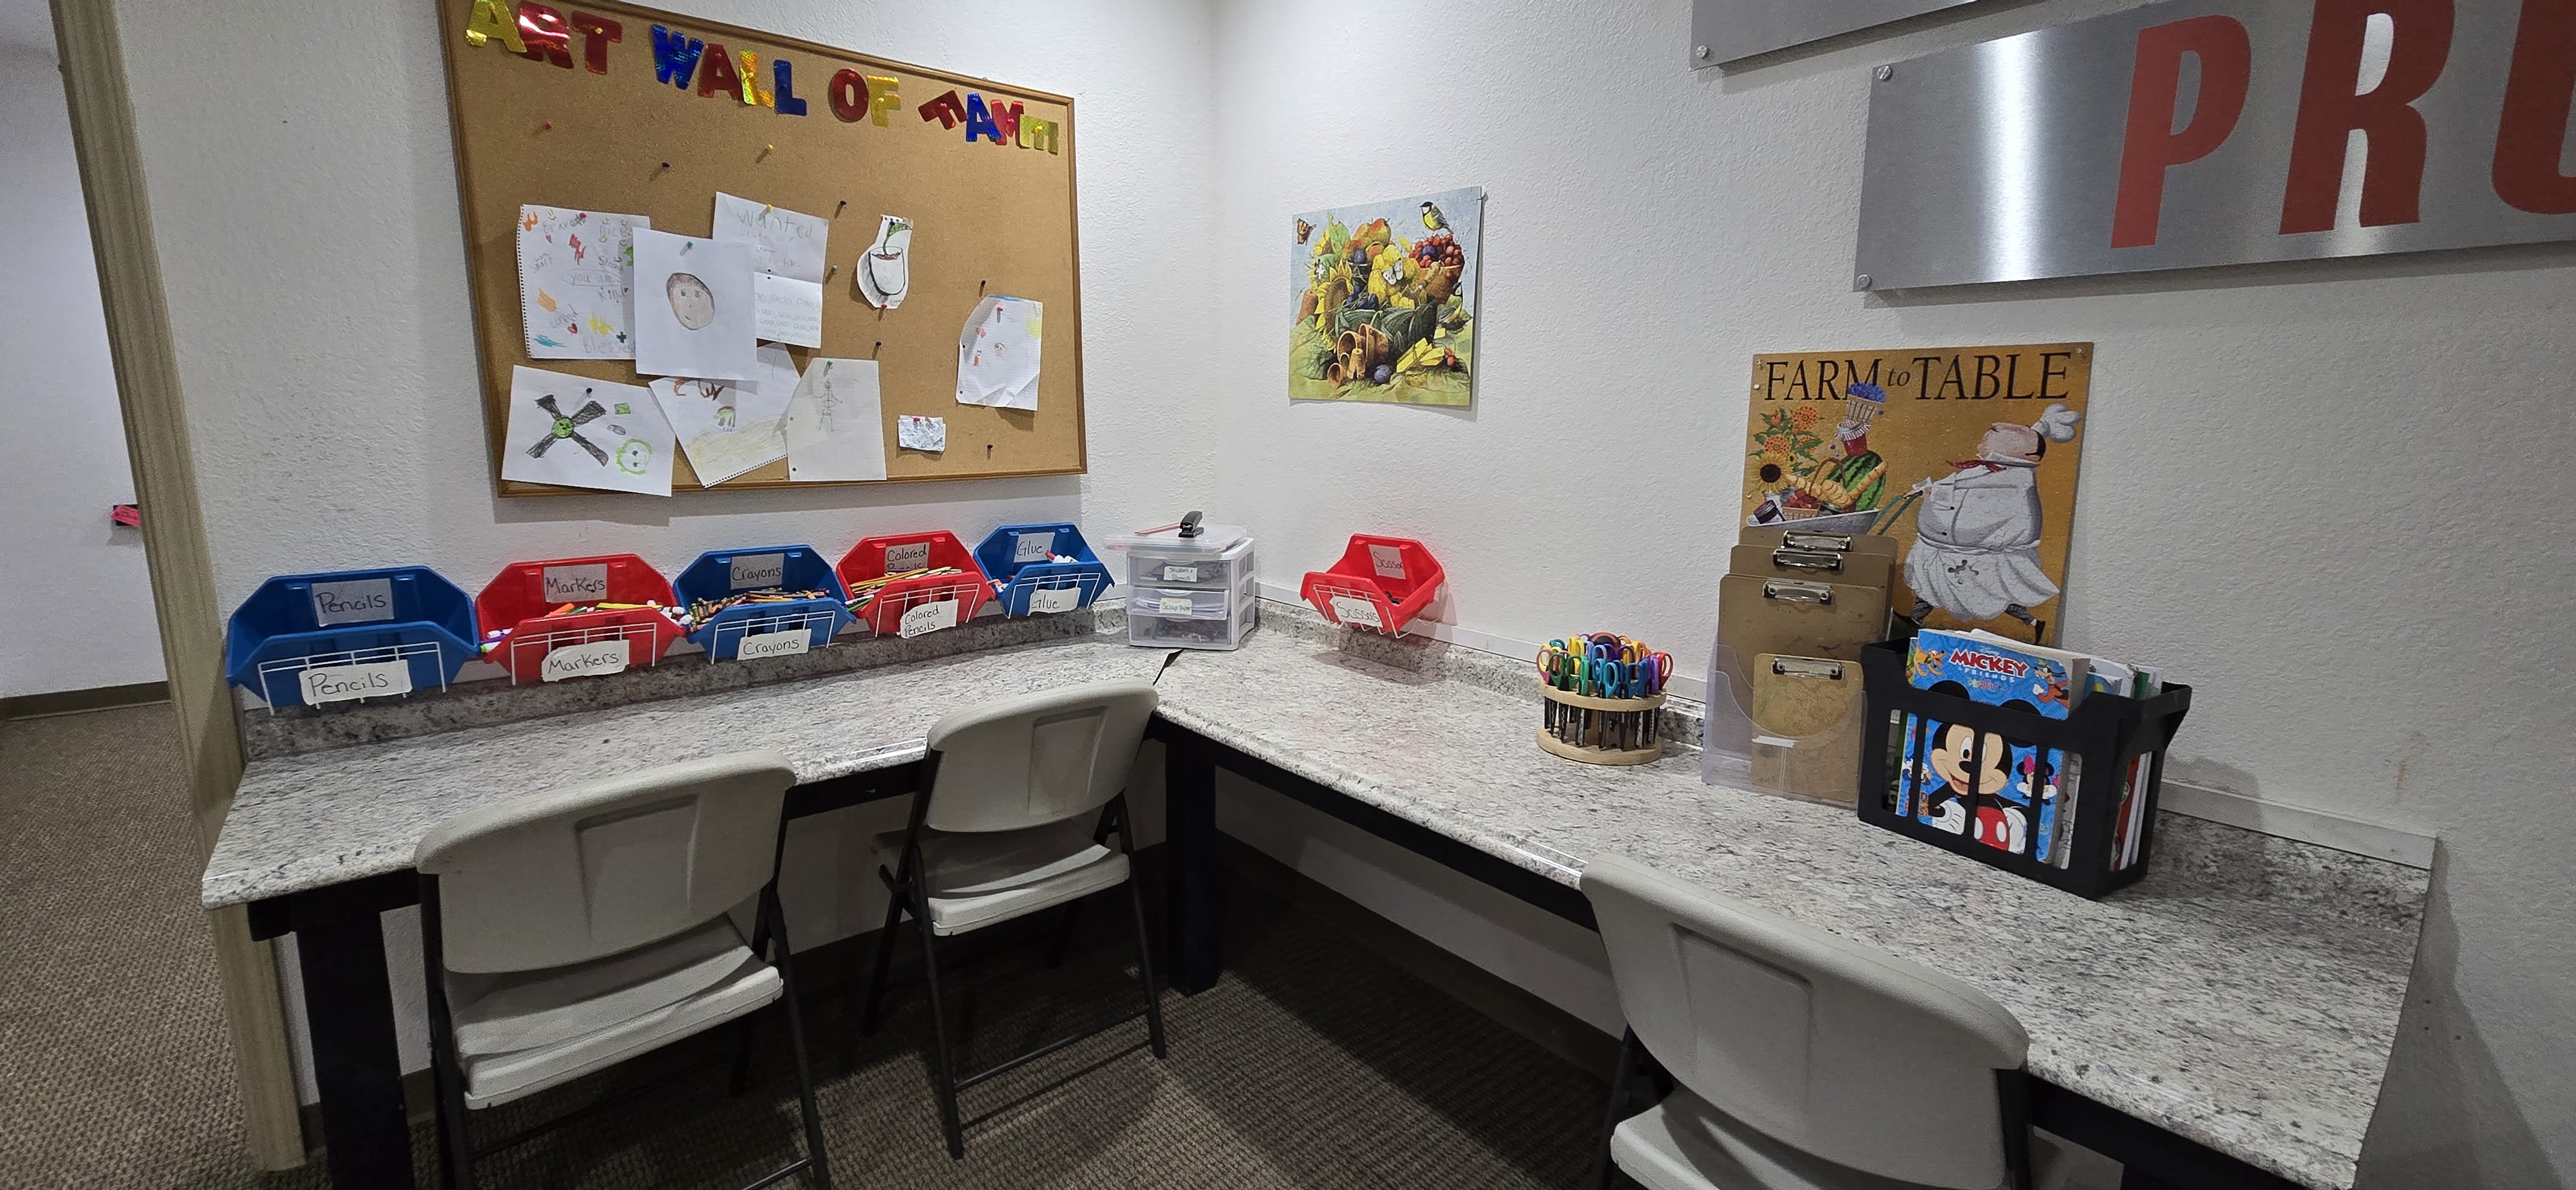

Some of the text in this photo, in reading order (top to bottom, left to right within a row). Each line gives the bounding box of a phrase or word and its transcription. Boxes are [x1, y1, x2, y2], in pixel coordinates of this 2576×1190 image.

[466, 0, 1059, 155] ART WALL OF FAME
[737, 209, 813, 239] Wanted
[549, 304, 579, 328] Loved
[1764, 352, 2071, 401] FARM to TABLE
[887, 544, 927, 562] Colored
[1017, 540, 1043, 556] Glue
[732, 564, 782, 583] Crayons
[545, 576, 606, 594] Markers
[316, 592, 386, 617] Pencils
[1031, 593, 1060, 609] Glue
[905, 605, 940, 625] Colored
[904, 621, 936, 638] Pencils
[743, 637, 799, 657] Crayons
[547, 653, 620, 675] Markers
[1950, 649, 2029, 679] MICKEY
[308, 673, 390, 697] Pencils
